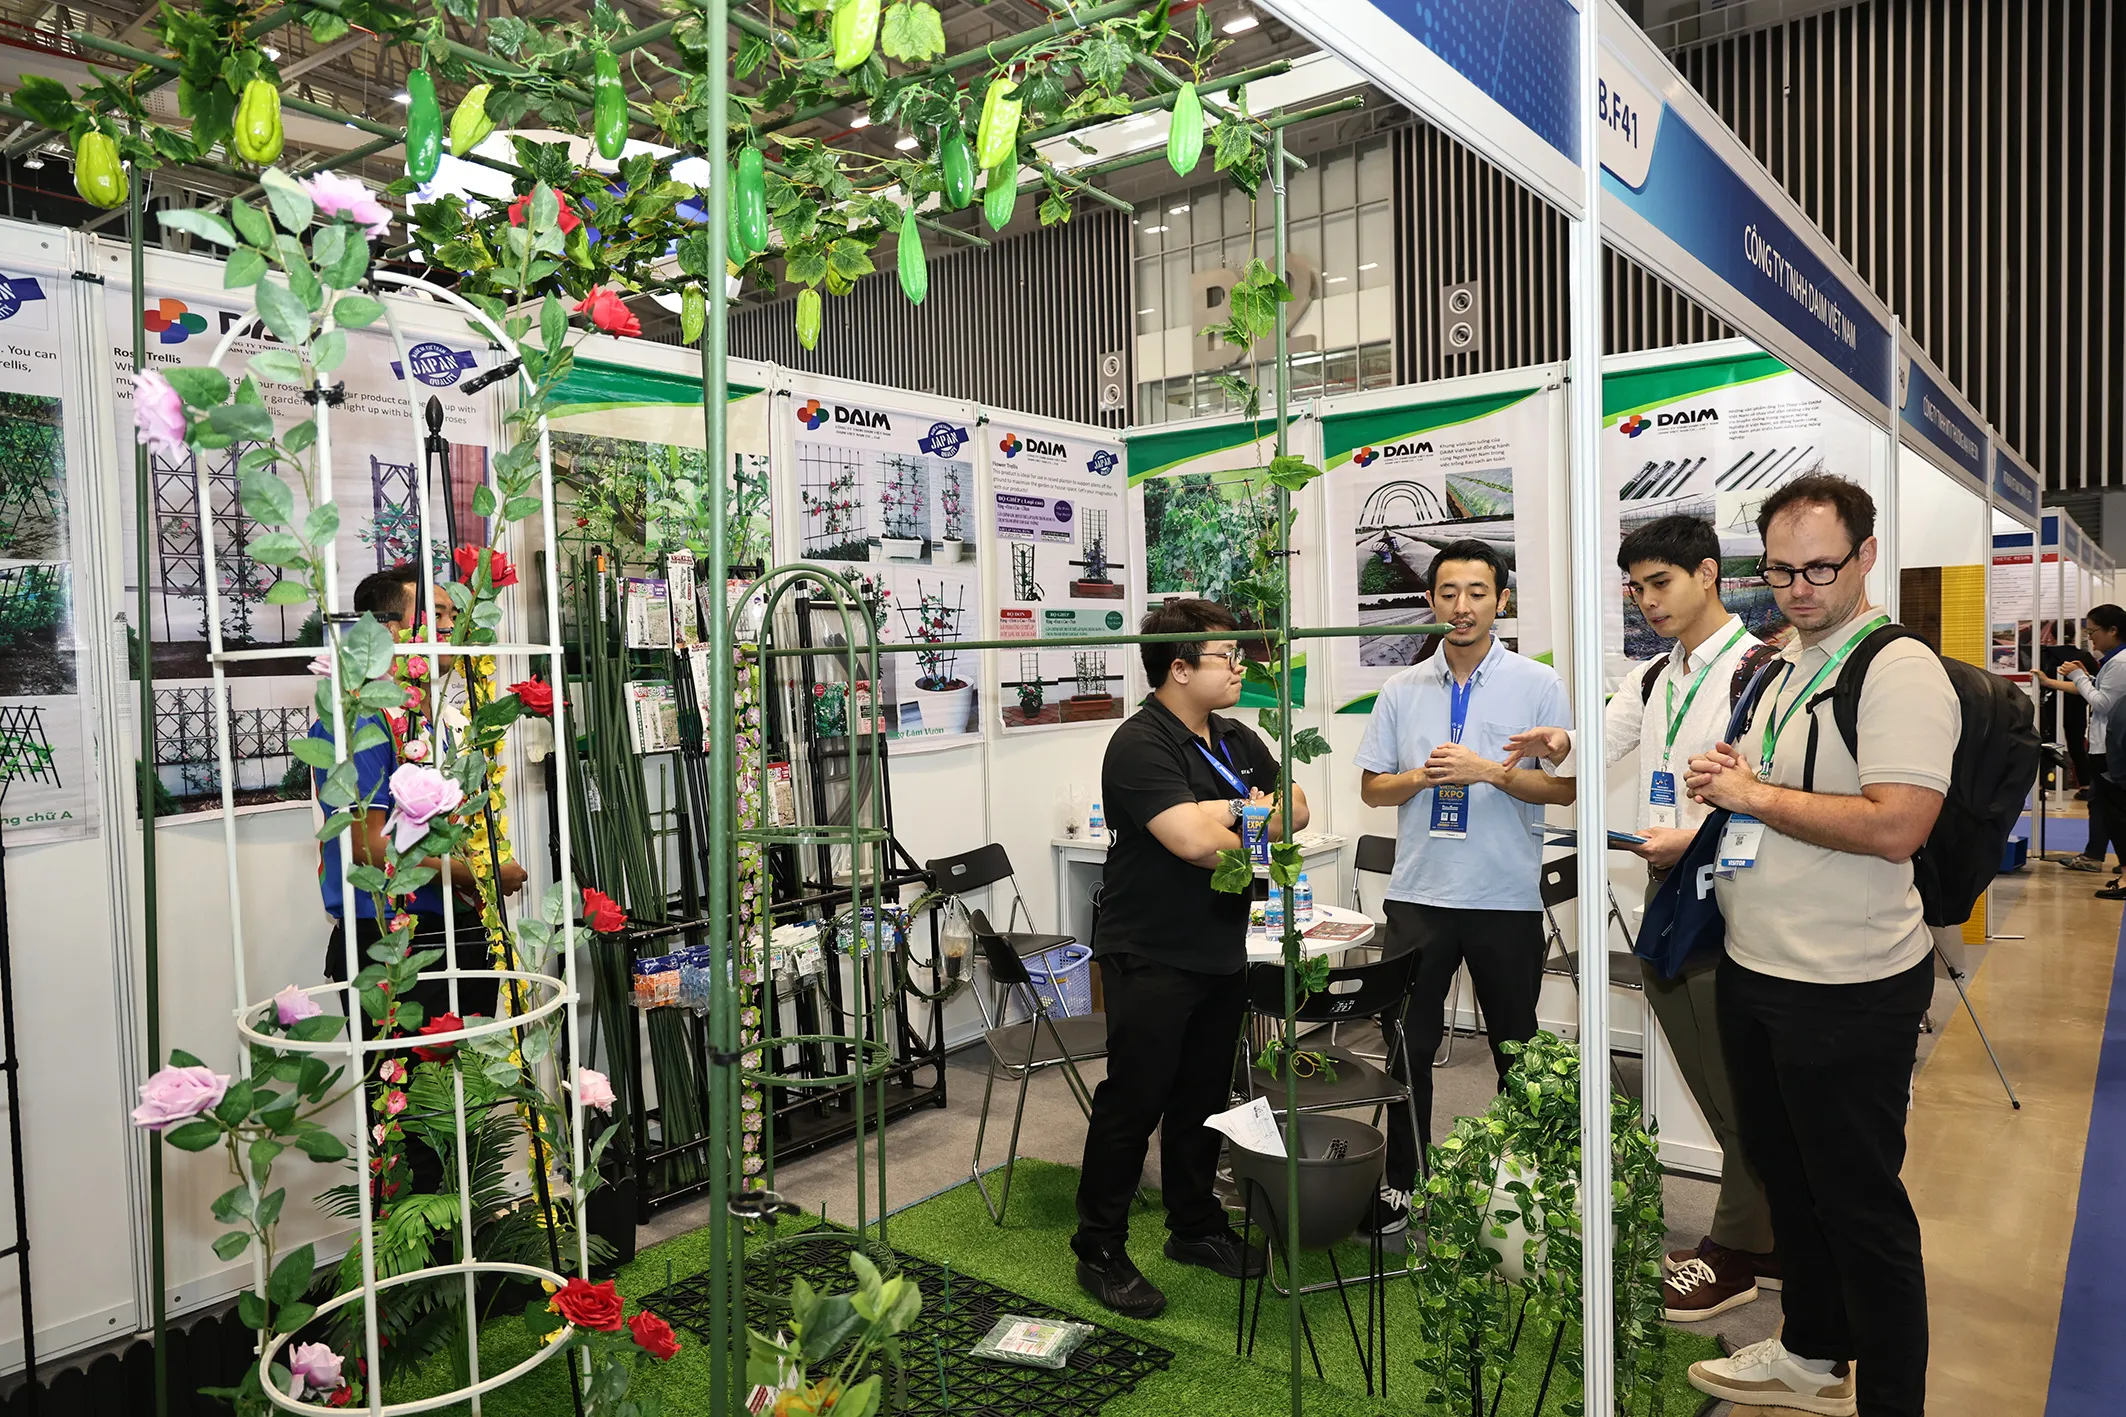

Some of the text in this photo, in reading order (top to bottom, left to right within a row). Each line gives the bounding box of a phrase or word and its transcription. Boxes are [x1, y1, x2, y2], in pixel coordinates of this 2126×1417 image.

[1598, 77, 1637, 149] B.F41
[1744, 224, 1772, 278] CÔNG
[1773, 249, 1784, 288] TY
[1785, 261, 1808, 309] TNHH
[1808, 283, 1827, 326] DAIM
[1841, 314, 1856, 350] NAM
[7, 345, 57, 360] You can
[114, 347, 182, 364] Ros Trellis
[412, 355, 459, 375] JAPAN
[429, 373, 457, 386] QUALITY
[360, 392, 396, 405] product
[445, 404, 456, 413] up
[457, 405, 477, 414] with
[343, 402, 366, 413] light
[367, 407, 379, 416] up
[381, 406, 401, 417] with
[445, 415, 467, 425] roses
[834, 405, 891, 431] DAIM
[1657, 407, 1719, 427] DAIM
[931, 431, 958, 449] JAPAN
[1026, 438, 1068, 458] DAIM
[1383, 441, 1434, 458] DAIM
[1439, 789, 1465, 799] EXPO
[26, 810, 73, 822] chữ A
[1727, 859, 1747, 867] VISITOR
